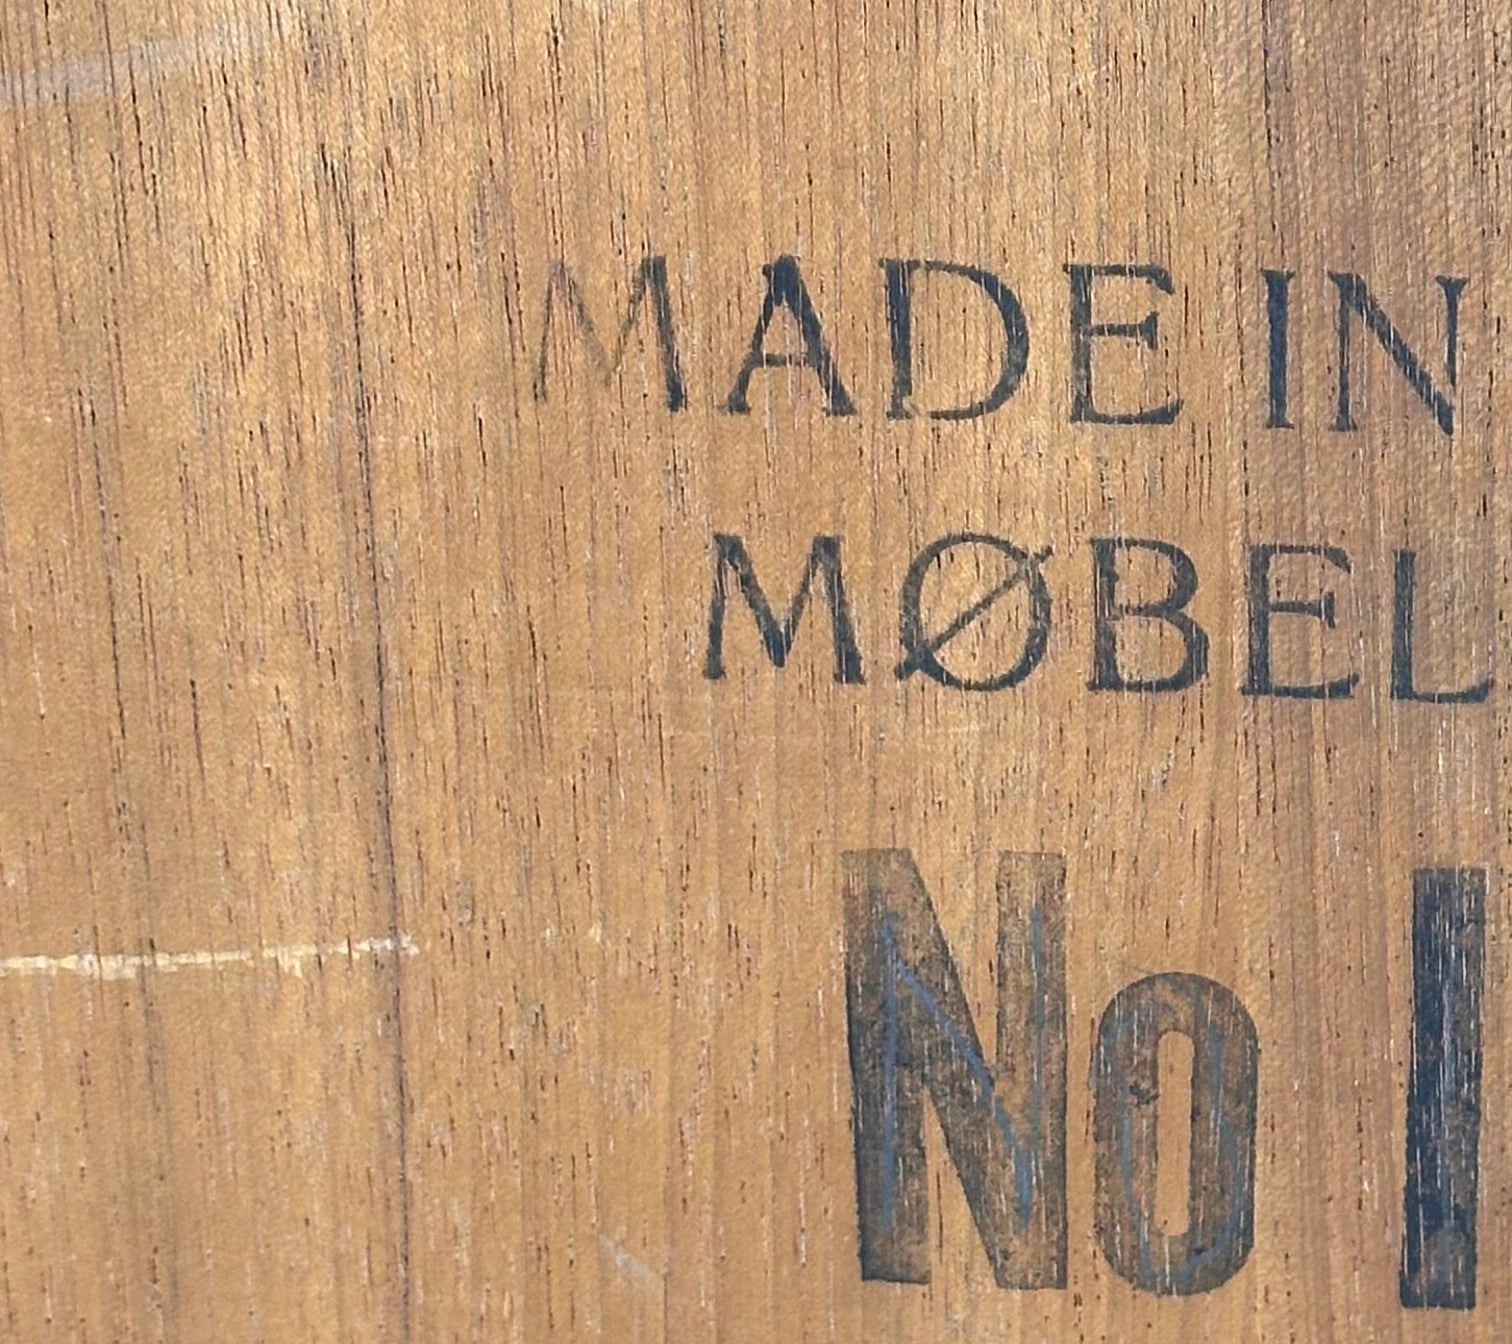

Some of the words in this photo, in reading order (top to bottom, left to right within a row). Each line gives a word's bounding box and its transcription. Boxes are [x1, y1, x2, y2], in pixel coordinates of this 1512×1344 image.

[534, 254, 1186, 425] MADE
[1261, 268, 1468, 436] IN
[842, 848, 1260, 1297] No
